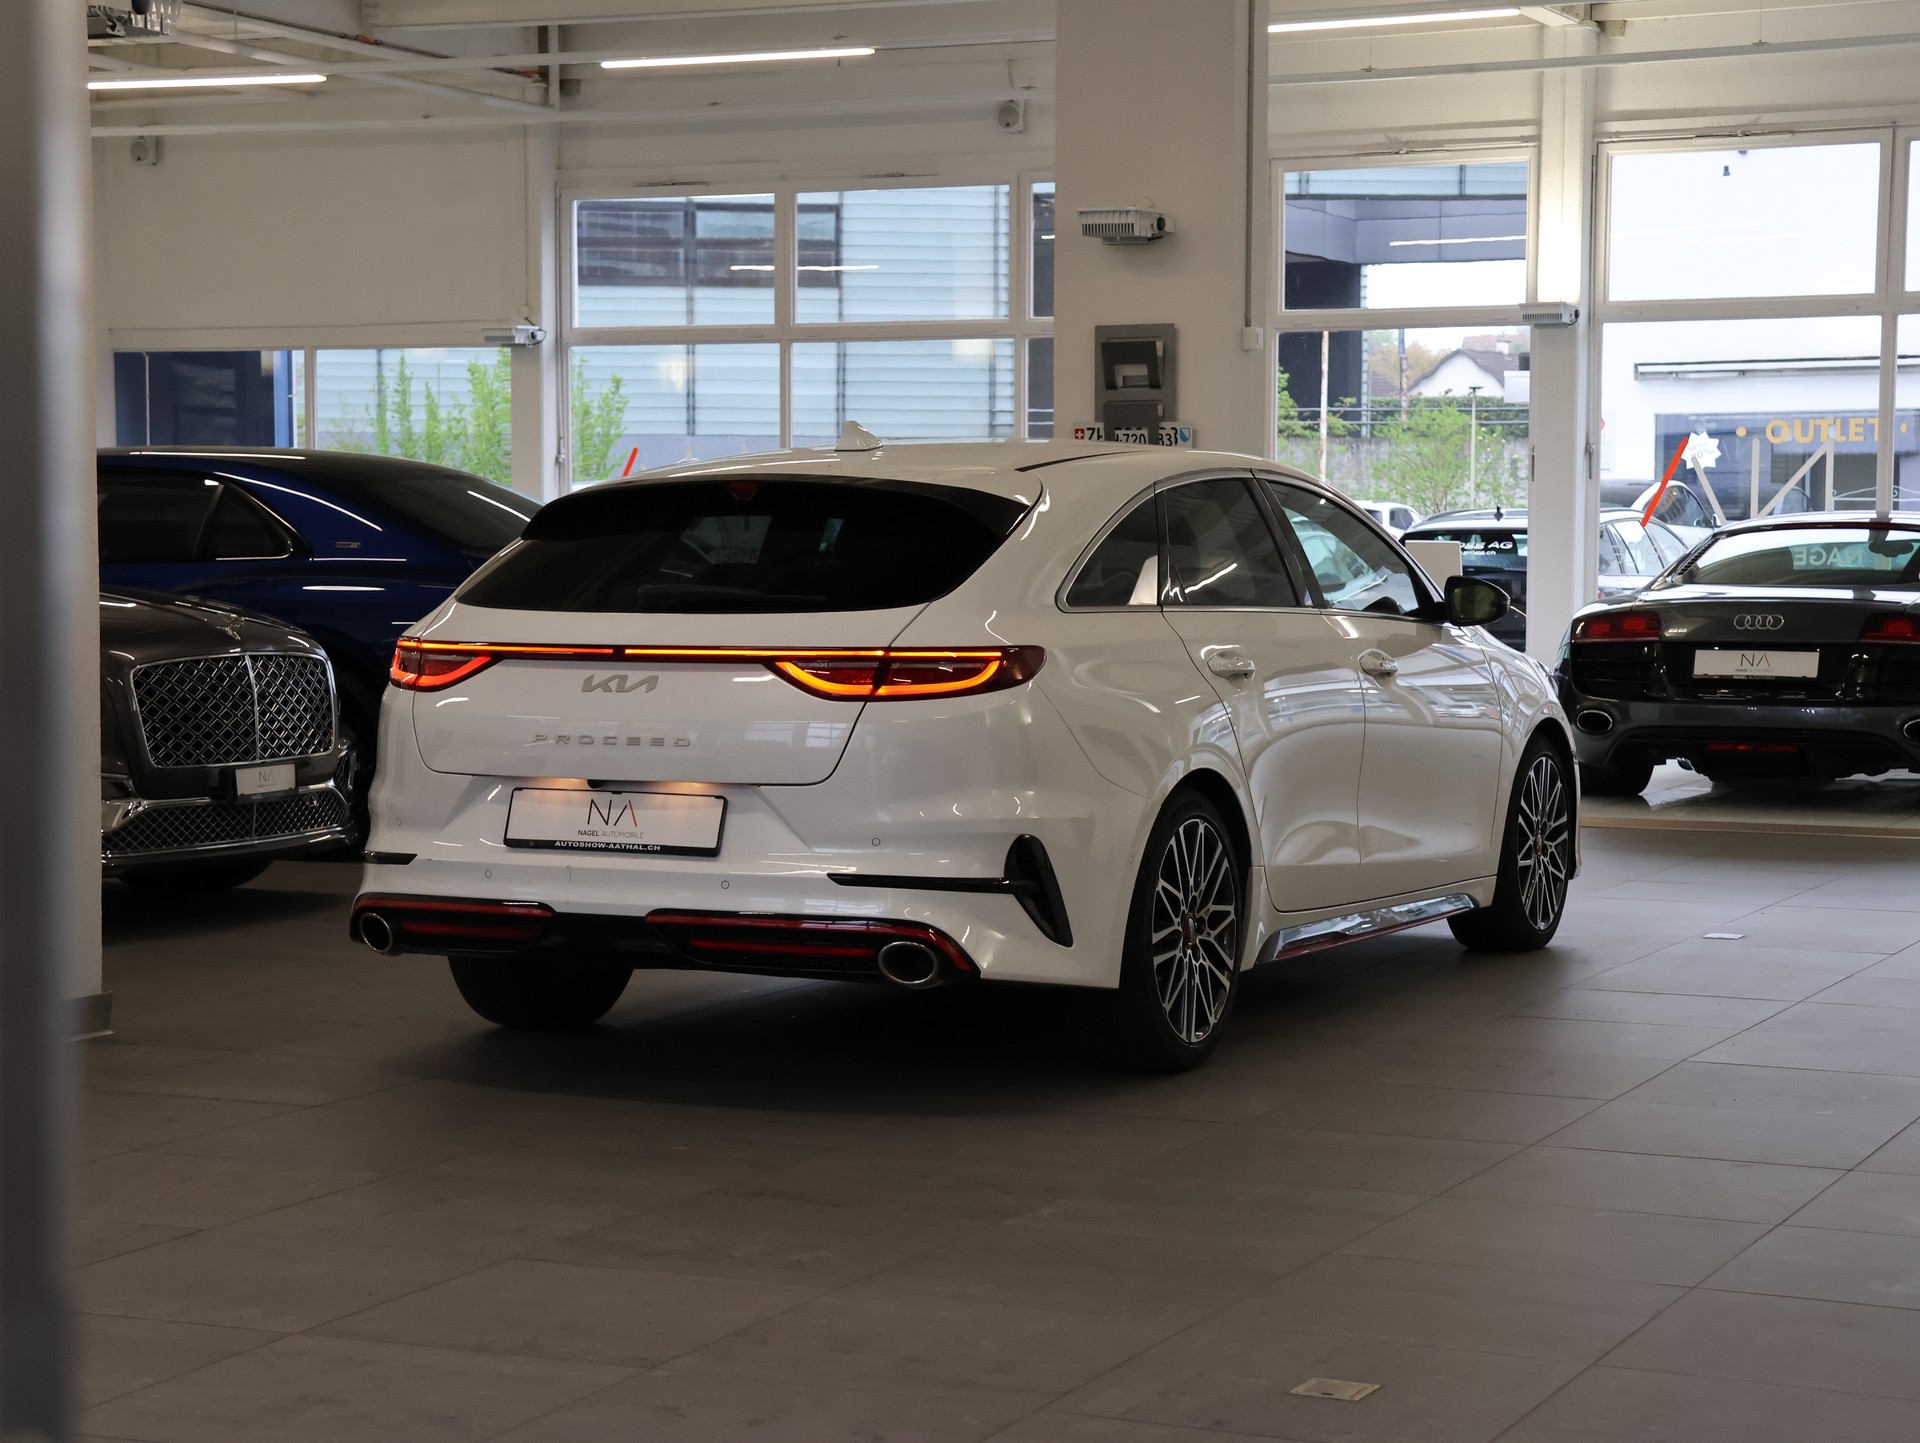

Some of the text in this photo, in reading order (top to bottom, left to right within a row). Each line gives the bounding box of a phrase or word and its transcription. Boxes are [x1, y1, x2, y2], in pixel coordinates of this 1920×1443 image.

[1488, 541, 1513, 549] AG
[581, 674, 659, 693] KIA
[532, 733, 691, 748] PROCEED
[587, 798, 637, 827] NA
[601, 830, 644, 839] AUTOMOBILE
[554, 840, 661, 851] AUTOSHOW-AATHAL.CH
